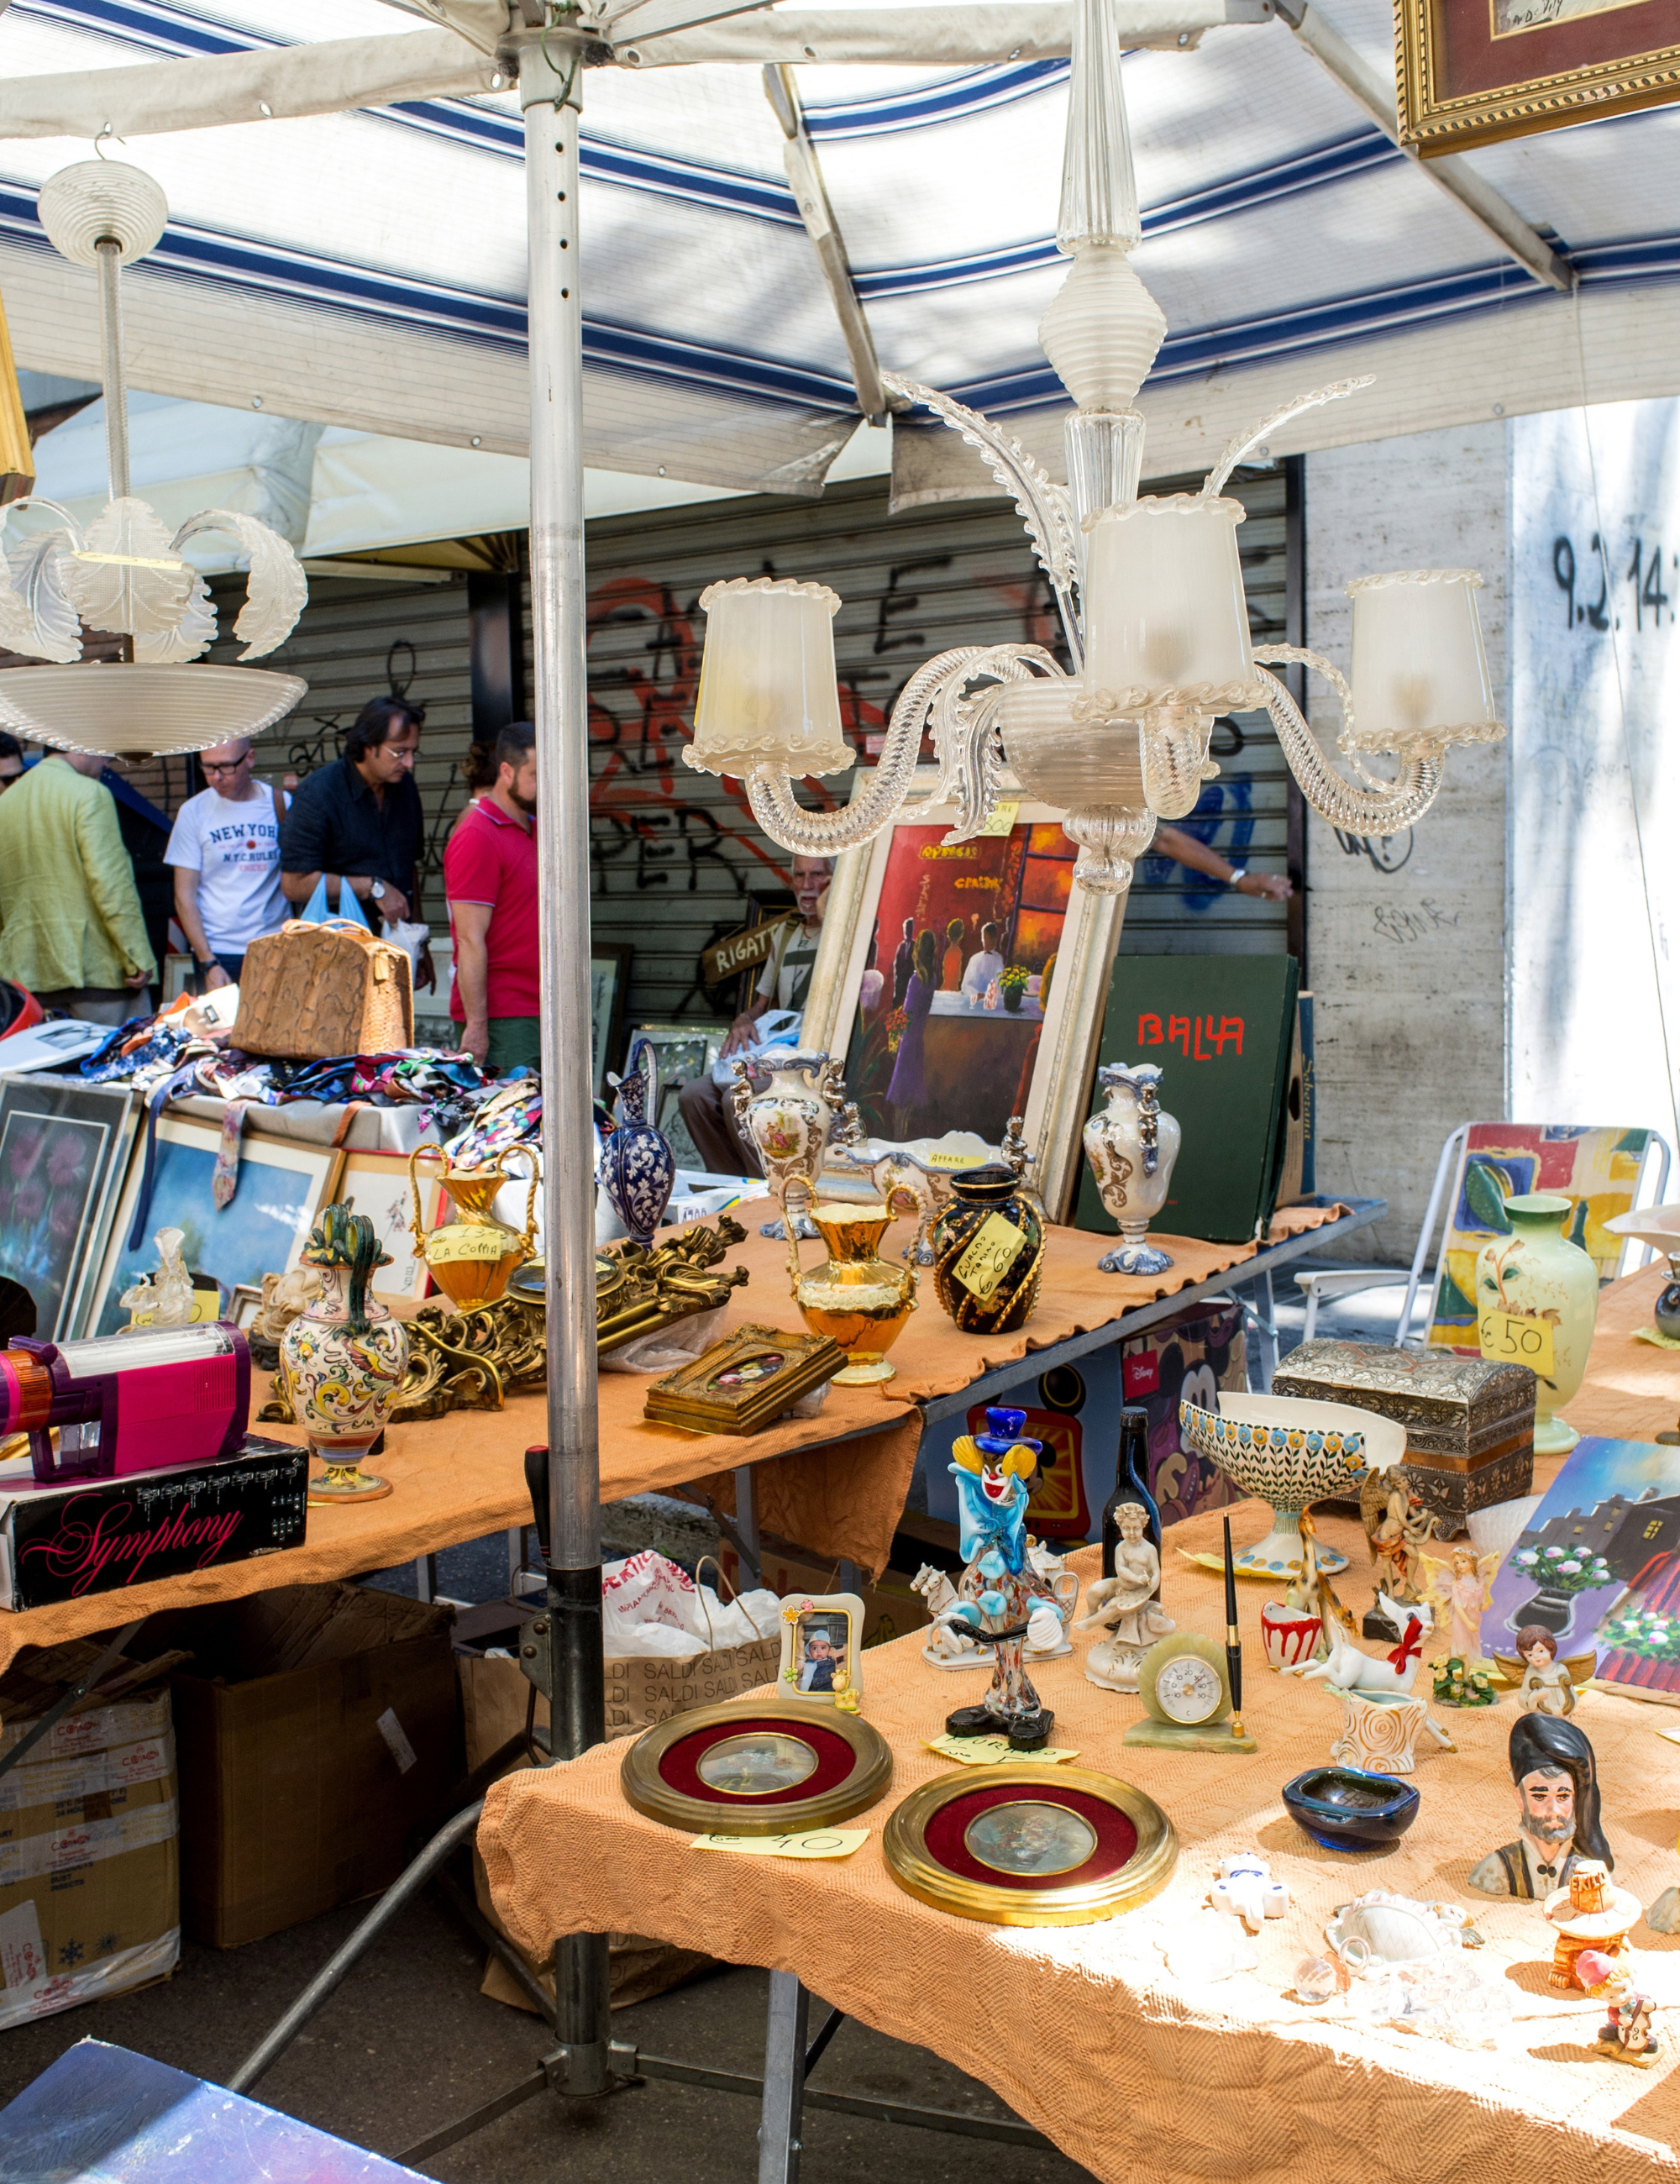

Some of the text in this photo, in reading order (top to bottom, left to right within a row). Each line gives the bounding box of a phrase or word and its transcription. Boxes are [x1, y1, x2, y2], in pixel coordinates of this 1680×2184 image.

[209, 824, 244, 844] NEW
[1137, 1012, 1245, 1061] BALLA
[931, 1154, 965, 1165] AFFARE
[433, 1247, 451, 1261] LA
[1499, 1319, 1542, 1354] 50
[18, 1493, 244, 1596] Symphony
[643, 1662, 696, 1679] SALDI
[702, 1653, 735, 1675] SALDI
[644, 1685, 698, 1703] SALDI
[704, 1675, 738, 1698] SALDI
[770, 1834, 843, 1851] 40
